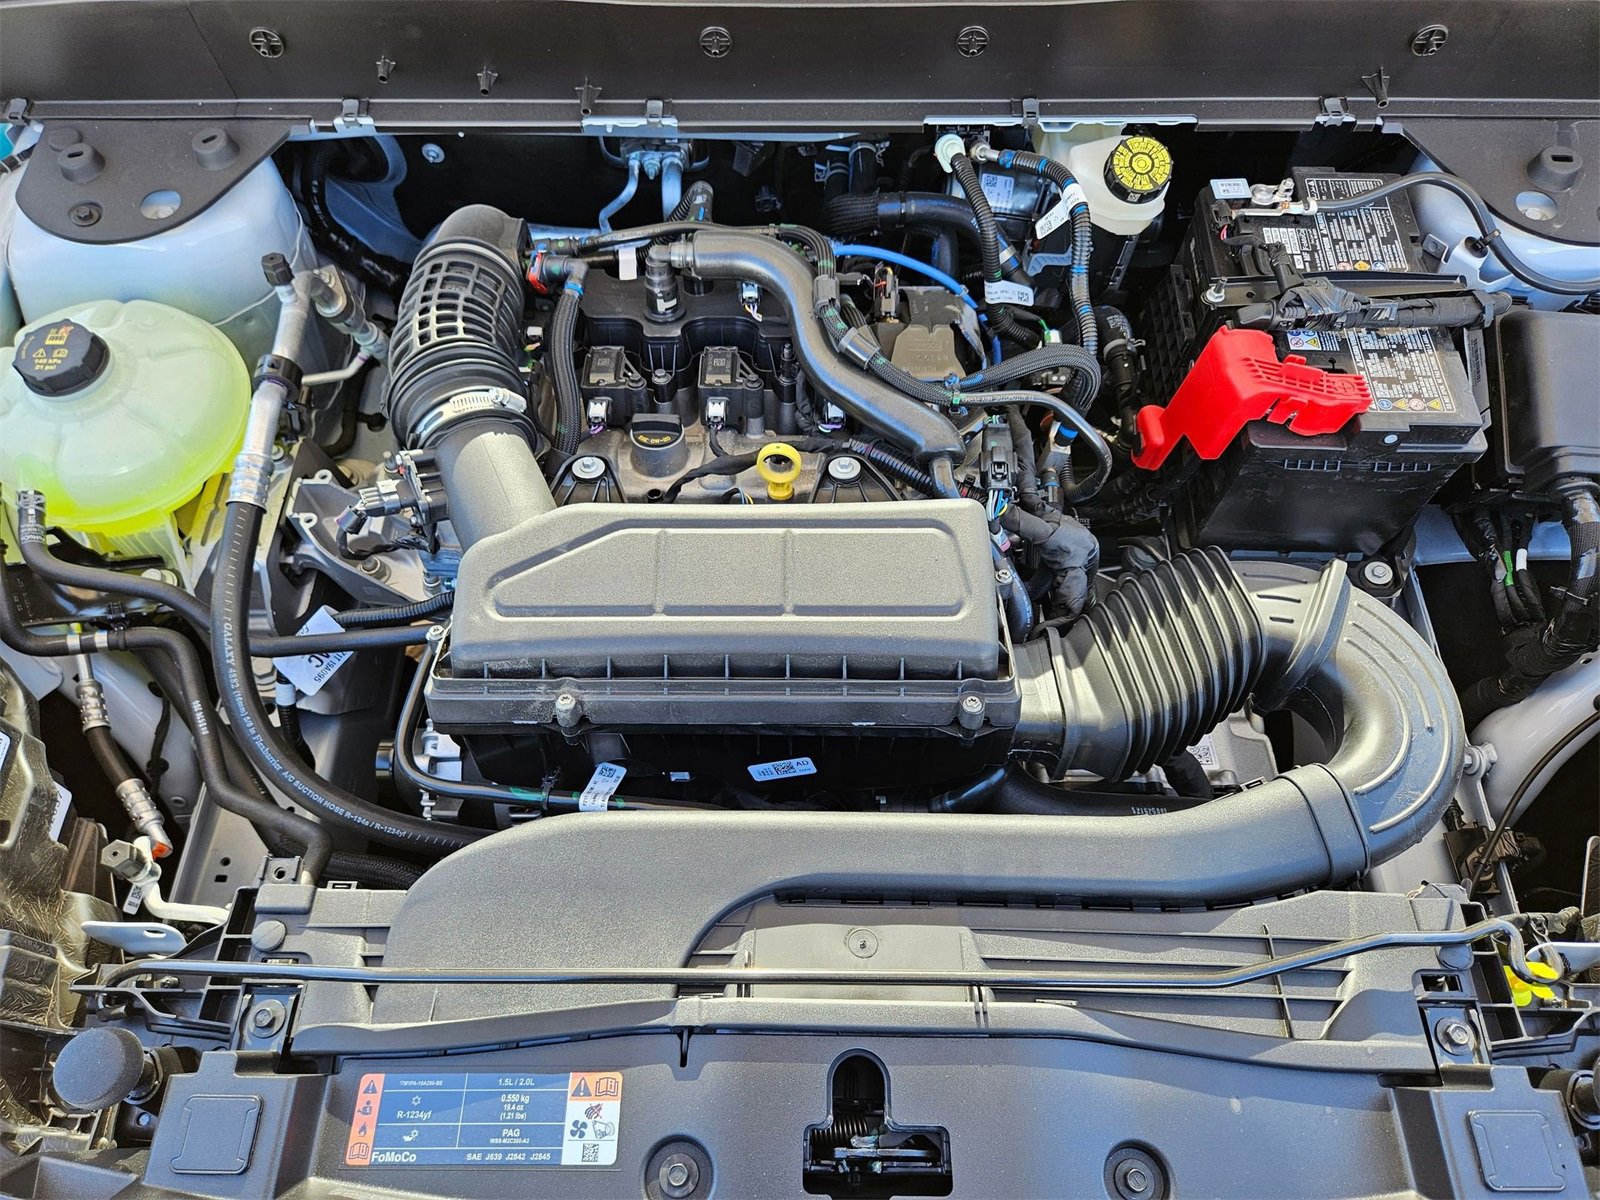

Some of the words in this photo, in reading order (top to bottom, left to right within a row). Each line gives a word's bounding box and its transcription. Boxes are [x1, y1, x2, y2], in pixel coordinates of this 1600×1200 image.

[313, 660, 337, 683] 19A095
[223, 622, 236, 666] GALAXY
[252, 733, 283, 772] Flexbarrier
[282, 770, 295, 783] A/C
[293, 780, 325, 806] SUCTION
[322, 800, 345, 816] HOSE
[344, 811, 370, 827] R-134a
[374, 822, 407, 838] R-1234yf
[498, 1078, 514, 1086] 1.5L
[519, 1078, 535, 1086] 2.0L
[501, 1094, 520, 1102] 0.550
[520, 1094, 530, 1104] kg
[396, 1110, 432, 1120] R-1234yf
[502, 1129, 521, 1137] PAG
[371, 1152, 417, 1162] FoMoCo
